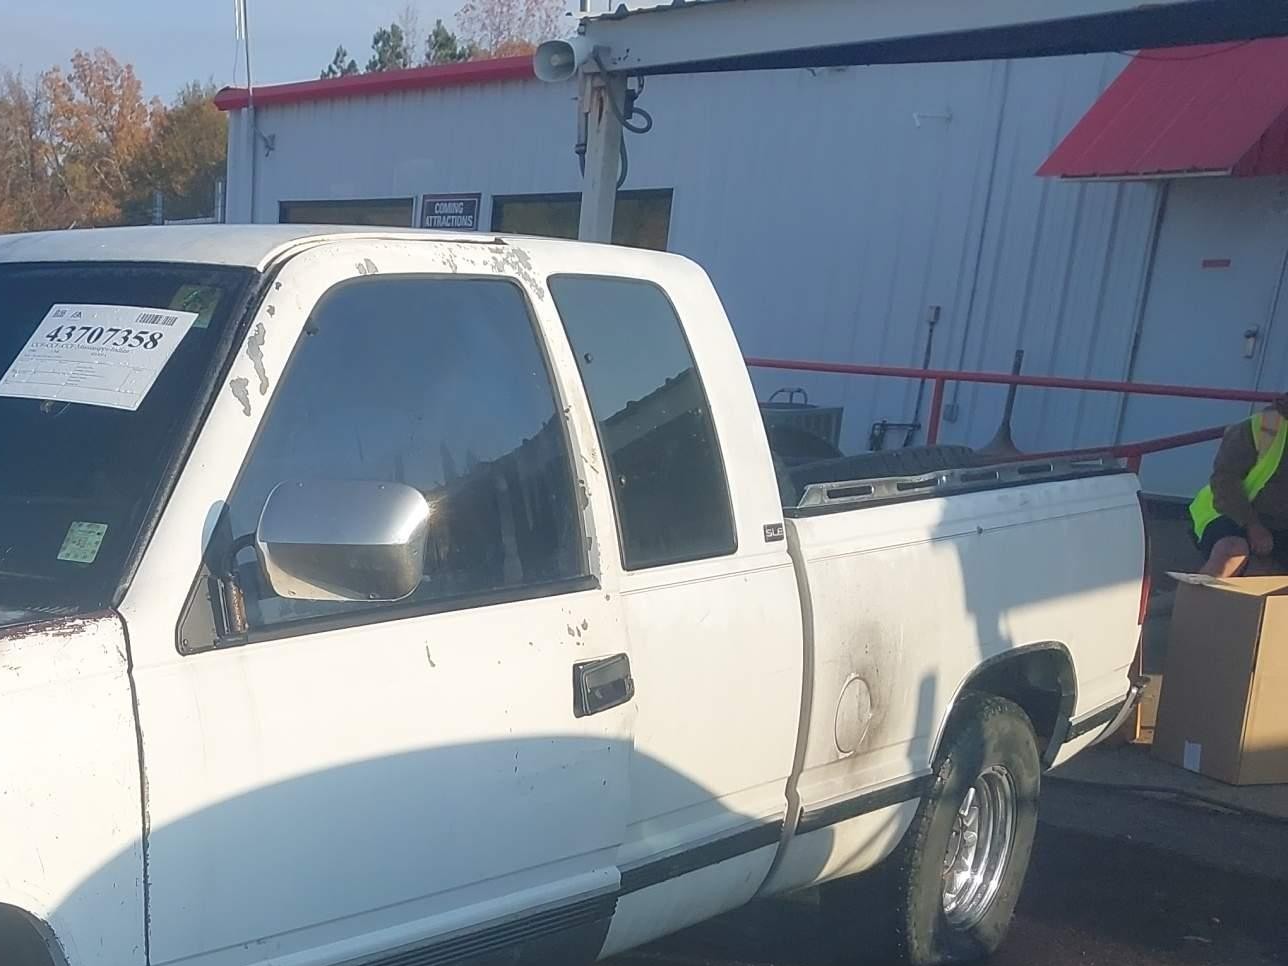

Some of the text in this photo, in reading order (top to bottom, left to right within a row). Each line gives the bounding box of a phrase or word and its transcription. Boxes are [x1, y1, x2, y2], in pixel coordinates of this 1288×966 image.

[434, 202, 464, 214] COMING
[425, 215, 474, 227] ATTRACTIONS
[45, 325, 163, 350] 43707358
[765, 527, 784, 537] SLE
